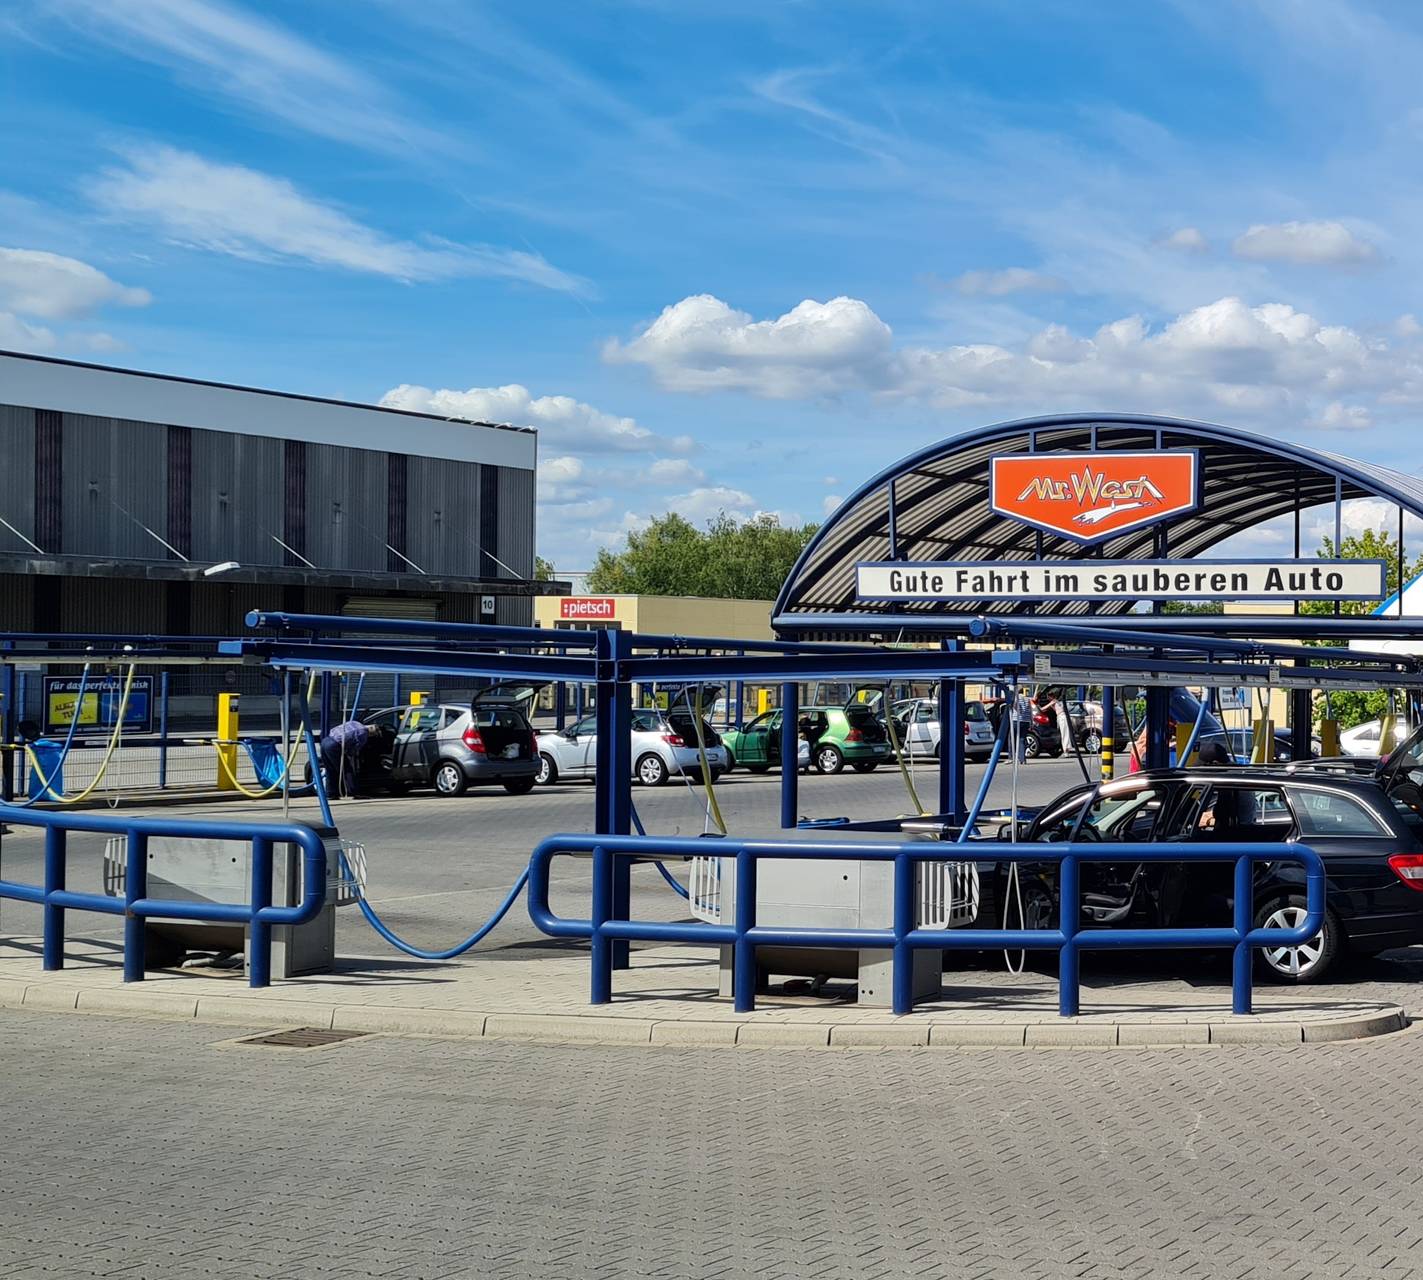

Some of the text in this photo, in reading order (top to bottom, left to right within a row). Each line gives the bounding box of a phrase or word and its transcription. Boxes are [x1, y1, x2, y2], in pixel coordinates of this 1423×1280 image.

[890, 567, 1344, 593] Gute Fahrt im sauberen Auto
[483, 600, 493, 609] 10
